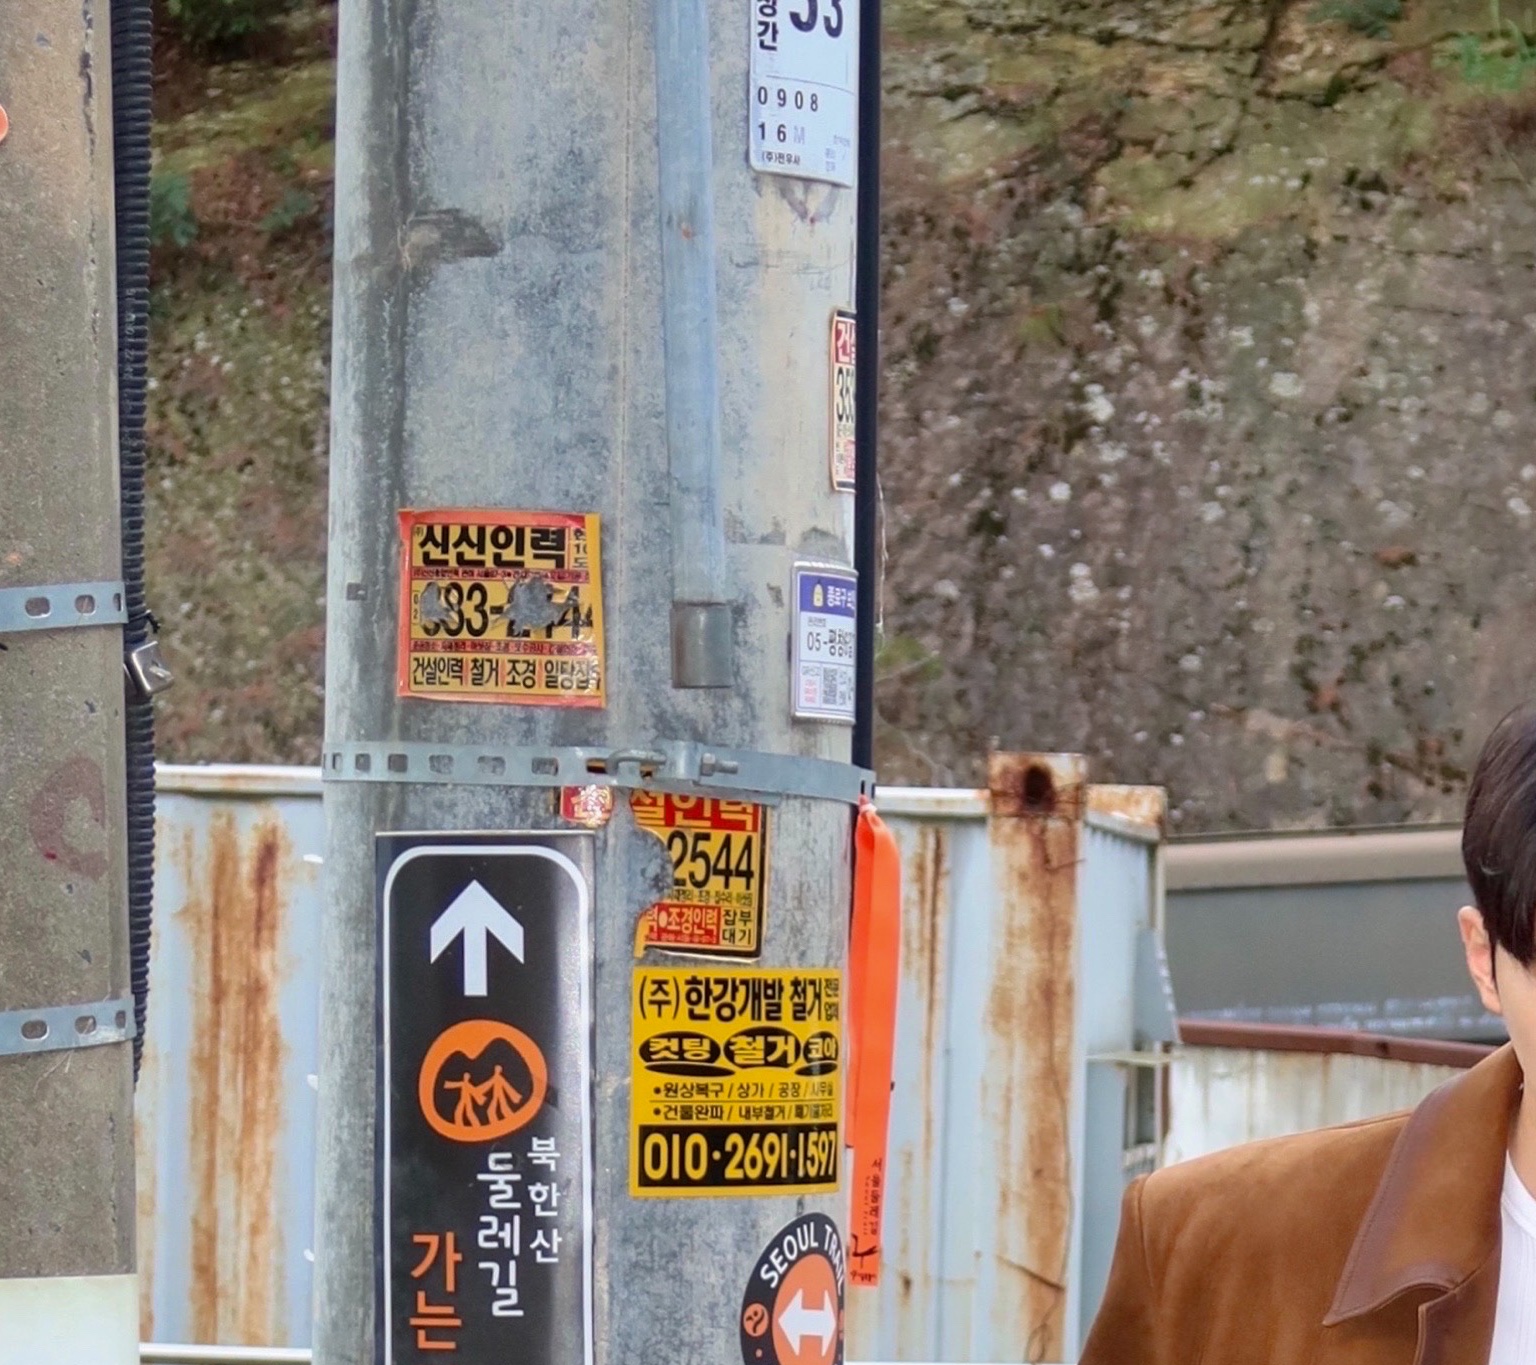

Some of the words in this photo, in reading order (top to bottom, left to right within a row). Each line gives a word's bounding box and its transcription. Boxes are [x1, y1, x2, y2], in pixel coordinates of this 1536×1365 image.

[757, 86, 819, 112] 0908
[419, 525, 567, 569] 신신인력
[412, 656, 465, 687] 건설인력
[470, 657, 499, 687] 철거
[506, 659, 536, 689] 조경
[667, 829, 755, 891] 2544
[722, 909, 752, 927] 잡부
[722, 928, 752, 945] 대기
[639, 976, 680, 1020] (주)
[684, 976, 784, 1023] 한강개발
[789, 976, 823, 1021] 철거
[648, 1037, 711, 1061] 컷팅
[729, 1035, 796, 1065] 철거
[663, 1081, 724, 1099] 원상복구
[737, 1082, 765, 1098] 상가
[778, 1082, 801, 1098] 공장
[526, 1136, 563, 1264] 북한산
[476, 1152, 525, 1317] 둘레길
[760, 1221, 819, 1289] SEOUL
[824, 1223, 845, 1296] TRAIL
[409, 1231, 463, 1350] 가는
